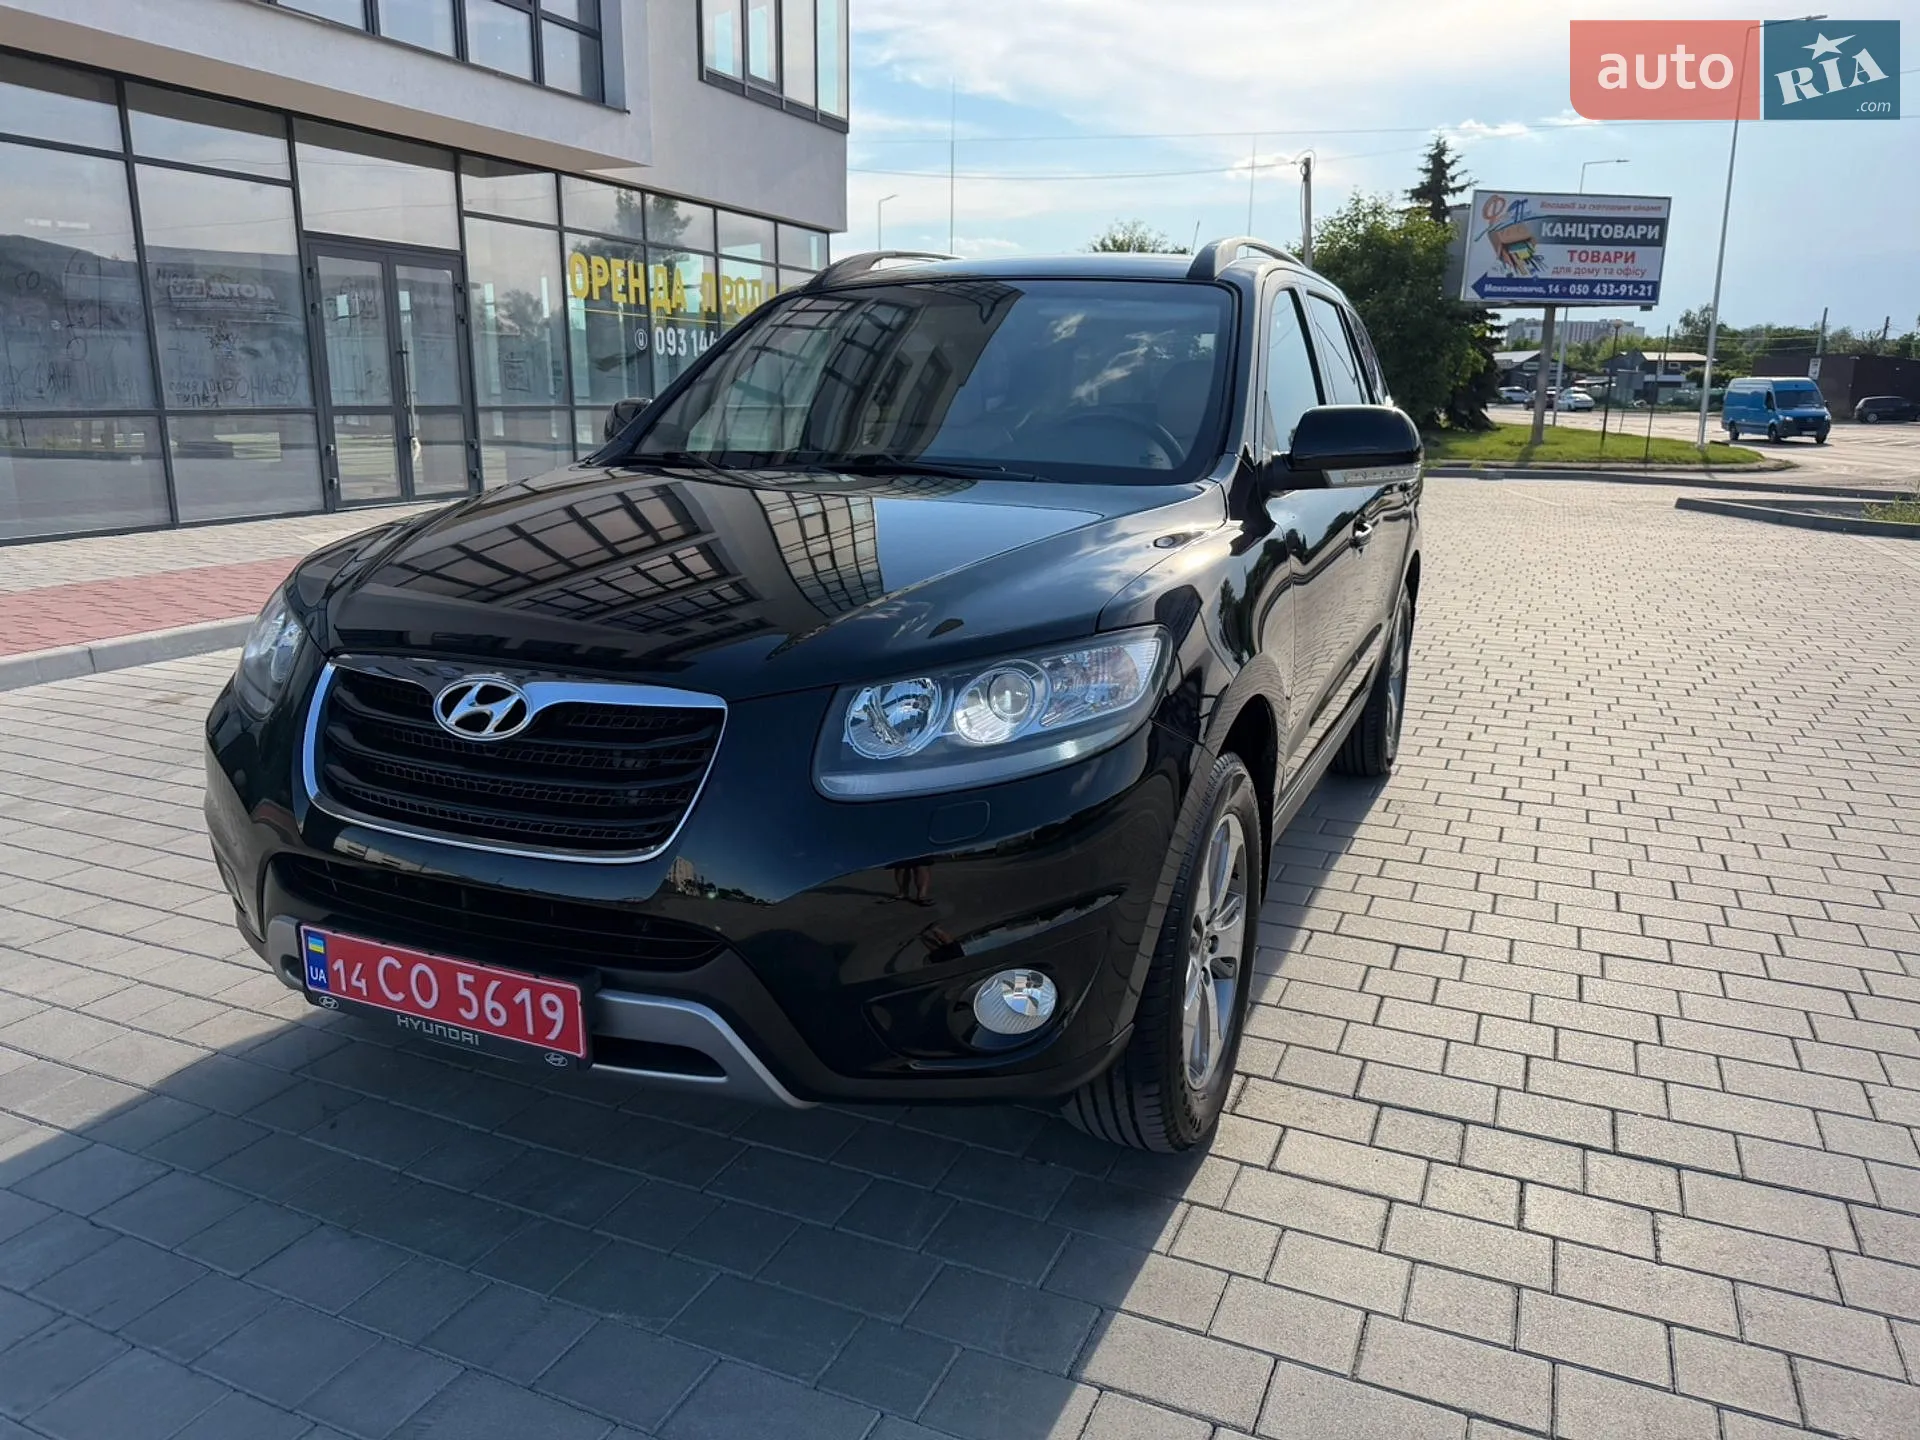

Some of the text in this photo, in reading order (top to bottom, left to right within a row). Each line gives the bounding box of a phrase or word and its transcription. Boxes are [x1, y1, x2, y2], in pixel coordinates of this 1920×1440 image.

[1541, 222, 1660, 240] КАНЦТОВАРИ
[1567, 250, 1636, 264] ТОВАРИ
[1552, 266, 1571, 275] для
[1573, 267, 1600, 276] дому
[1616, 266, 1647, 278] офісу
[569, 252, 687, 315] ОРЕНДА
[1569, 284, 1589, 295] 050
[1593, 283, 1652, 297] 433-91-21
[655, 326, 687, 357] 093
[310, 965, 327, 984] UA
[332, 956, 565, 1041] 14 CO 5619
[397, 1014, 480, 1046] HYUNDAI
